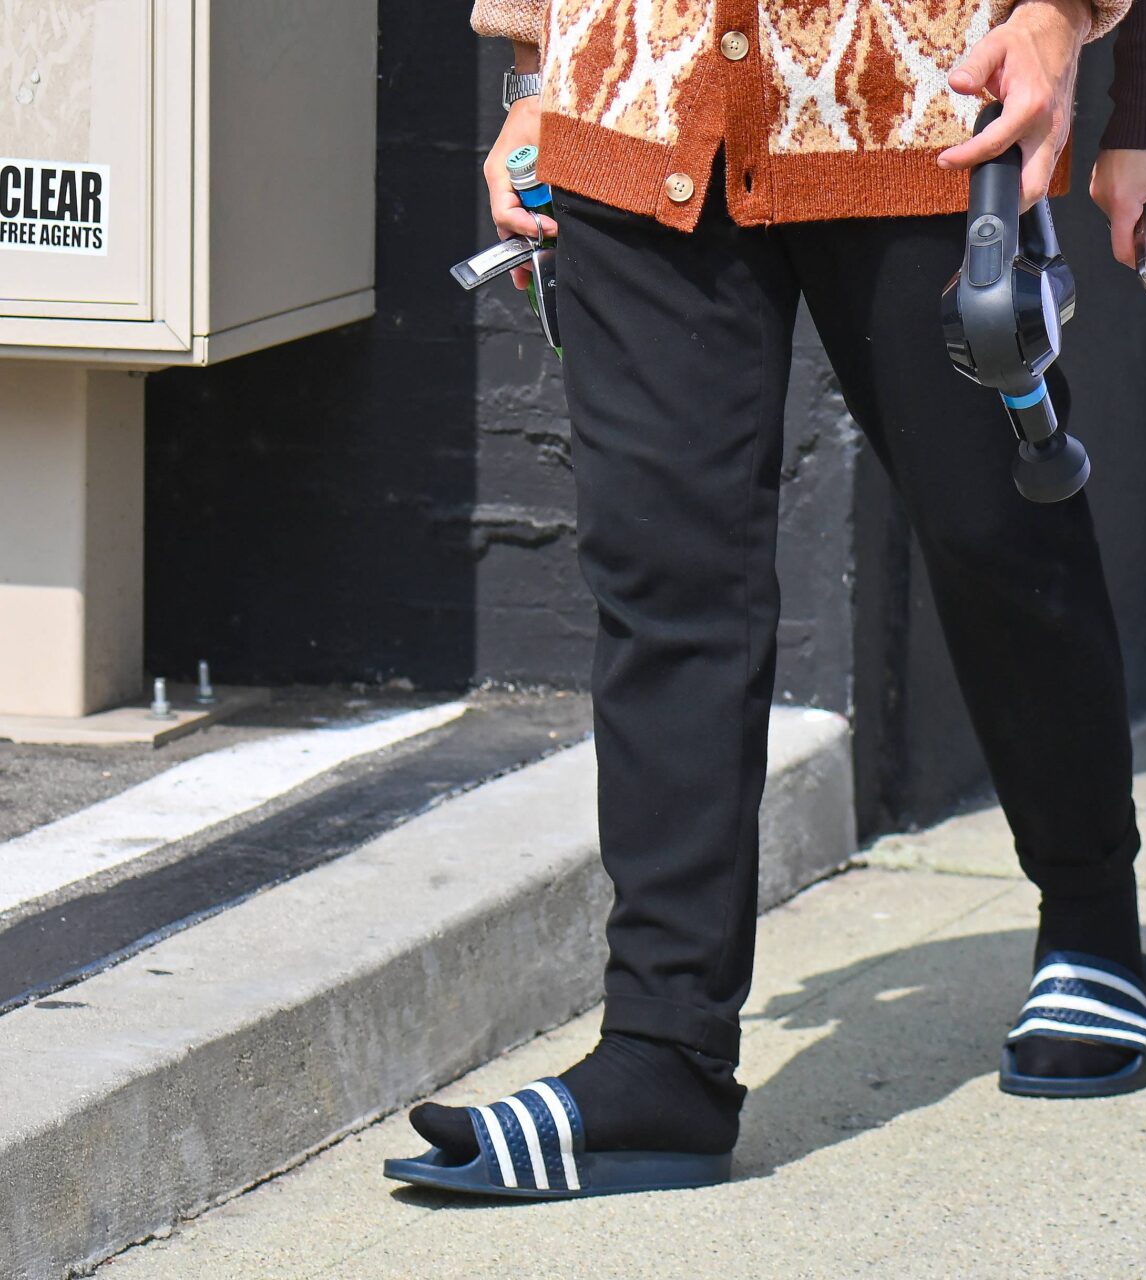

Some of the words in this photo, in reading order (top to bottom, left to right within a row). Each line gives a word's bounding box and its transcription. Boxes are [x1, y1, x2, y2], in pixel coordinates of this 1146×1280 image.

[0, 165, 102, 223] CLEAR
[0, 221, 36, 244] FREE
[39, 224, 102, 249] AGENTS
